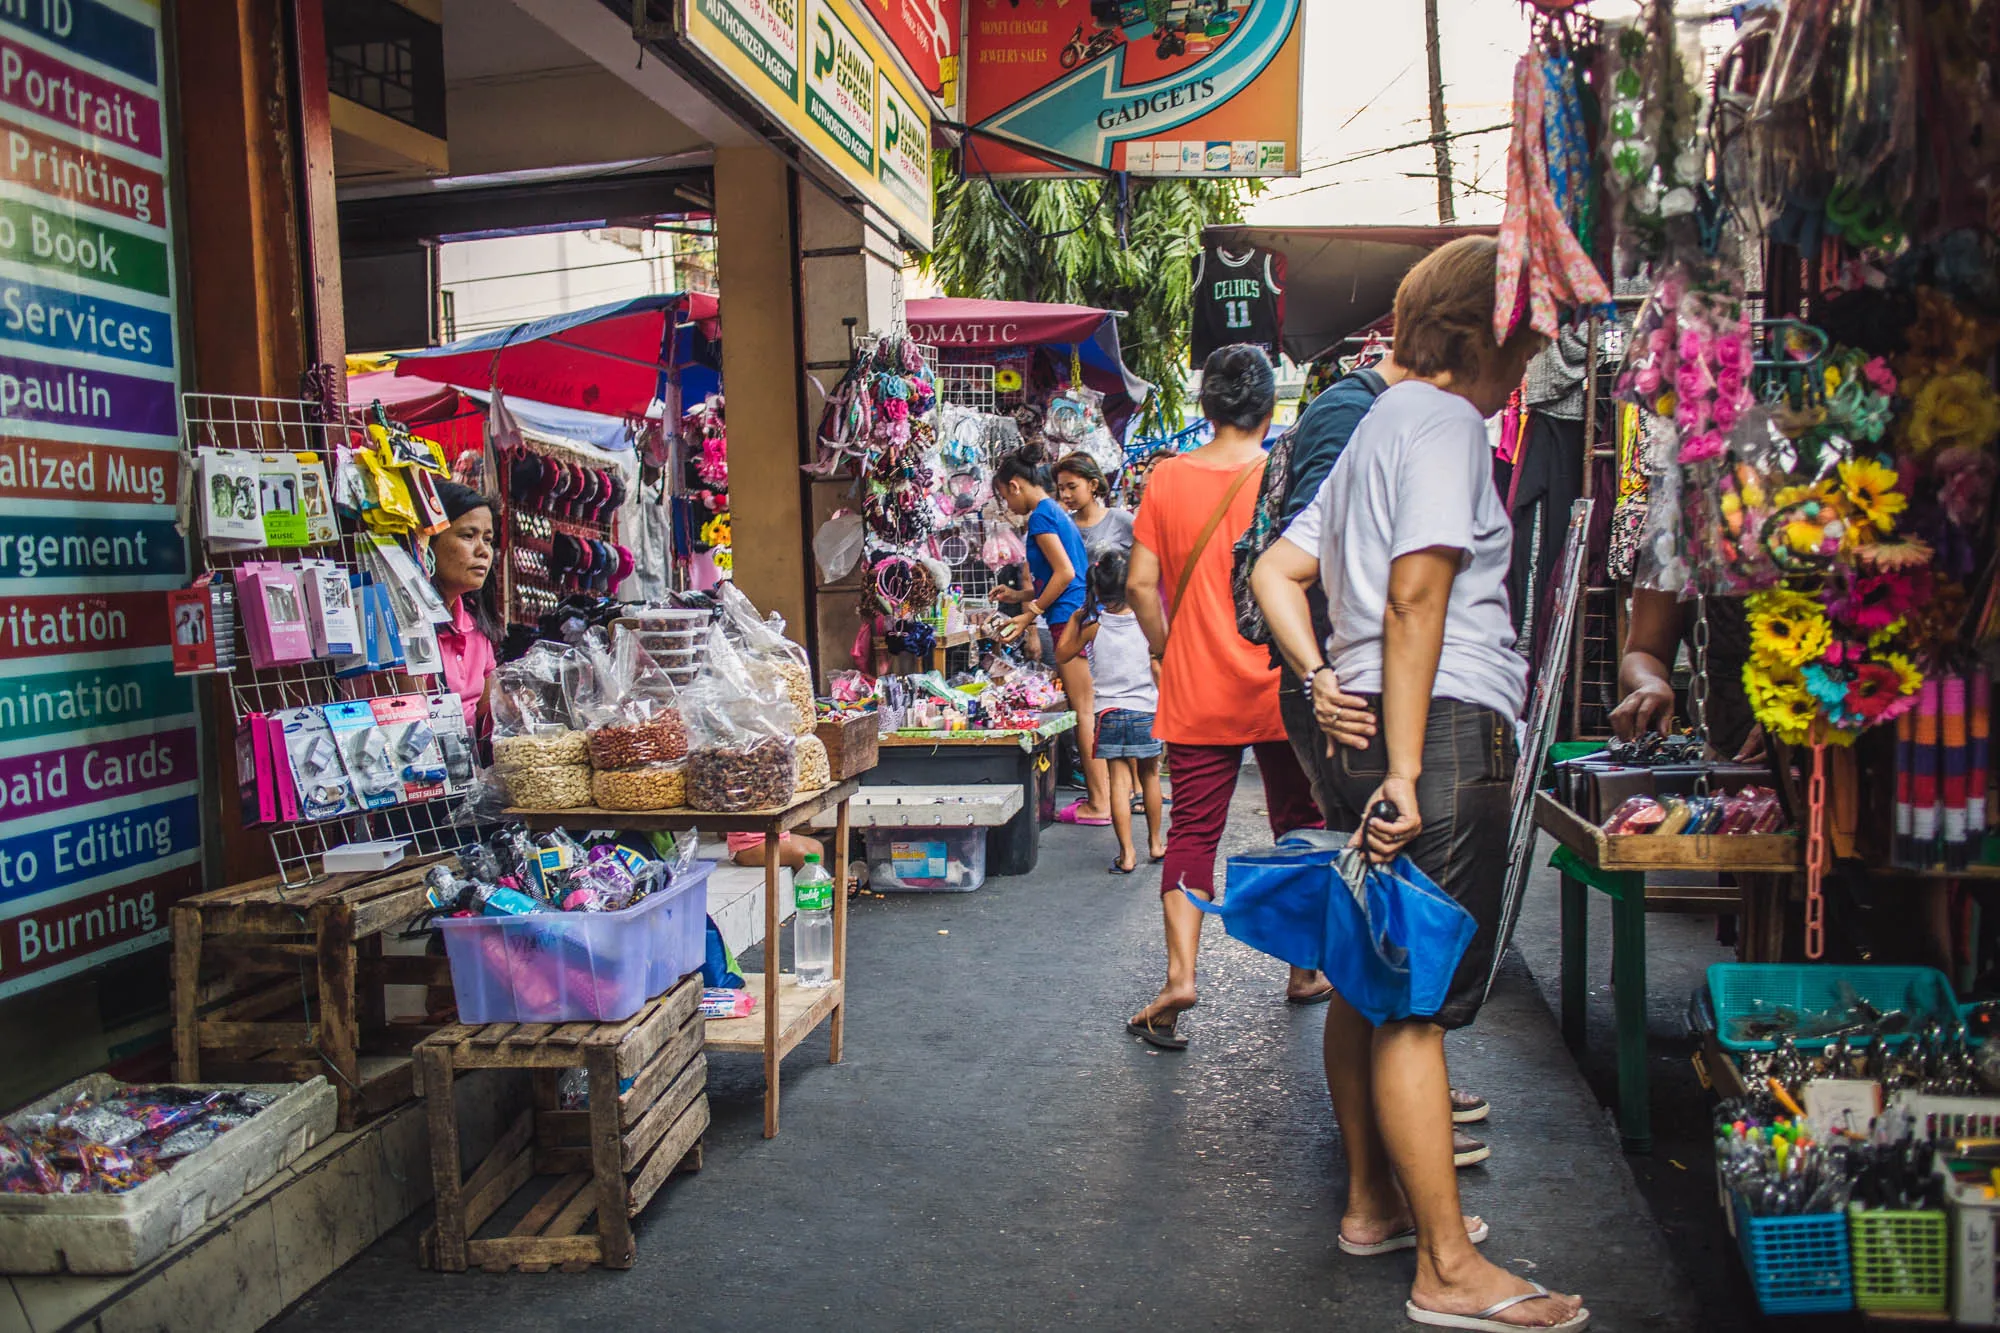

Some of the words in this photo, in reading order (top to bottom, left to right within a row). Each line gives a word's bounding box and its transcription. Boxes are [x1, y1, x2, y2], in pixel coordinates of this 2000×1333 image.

[706, 0, 765, 63] AUTHORIZED
[765, 51, 792, 90] AGENT
[1021, 48, 1048, 62] SALES
[2, 47, 140, 143] Portrait
[836, 62, 871, 116] EXPRESS
[1097, 77, 1214, 130] GADGETS
[811, 97, 852, 149] AUTHORIZED
[851, 136, 871, 166] AGENT
[8, 130, 152, 223] Printing
[32, 214, 118, 276] Book
[1213, 278, 1261, 301] CELTICS
[1225, 300, 1252, 328] 11
[4, 287, 153, 354] Services
[0, 372, 111, 419] paulin
[0, 445, 95, 491] alized
[107, 453, 166, 504] Mug
[0, 530, 148, 577] rgement
[83, 739, 174, 790] Cards
[408, 792, 422, 800] BEST
[423, 788, 444, 798] SELLER
[0, 847, 38, 888] to
[53, 815, 173, 874] Editing
[18, 890, 158, 964] Burning
